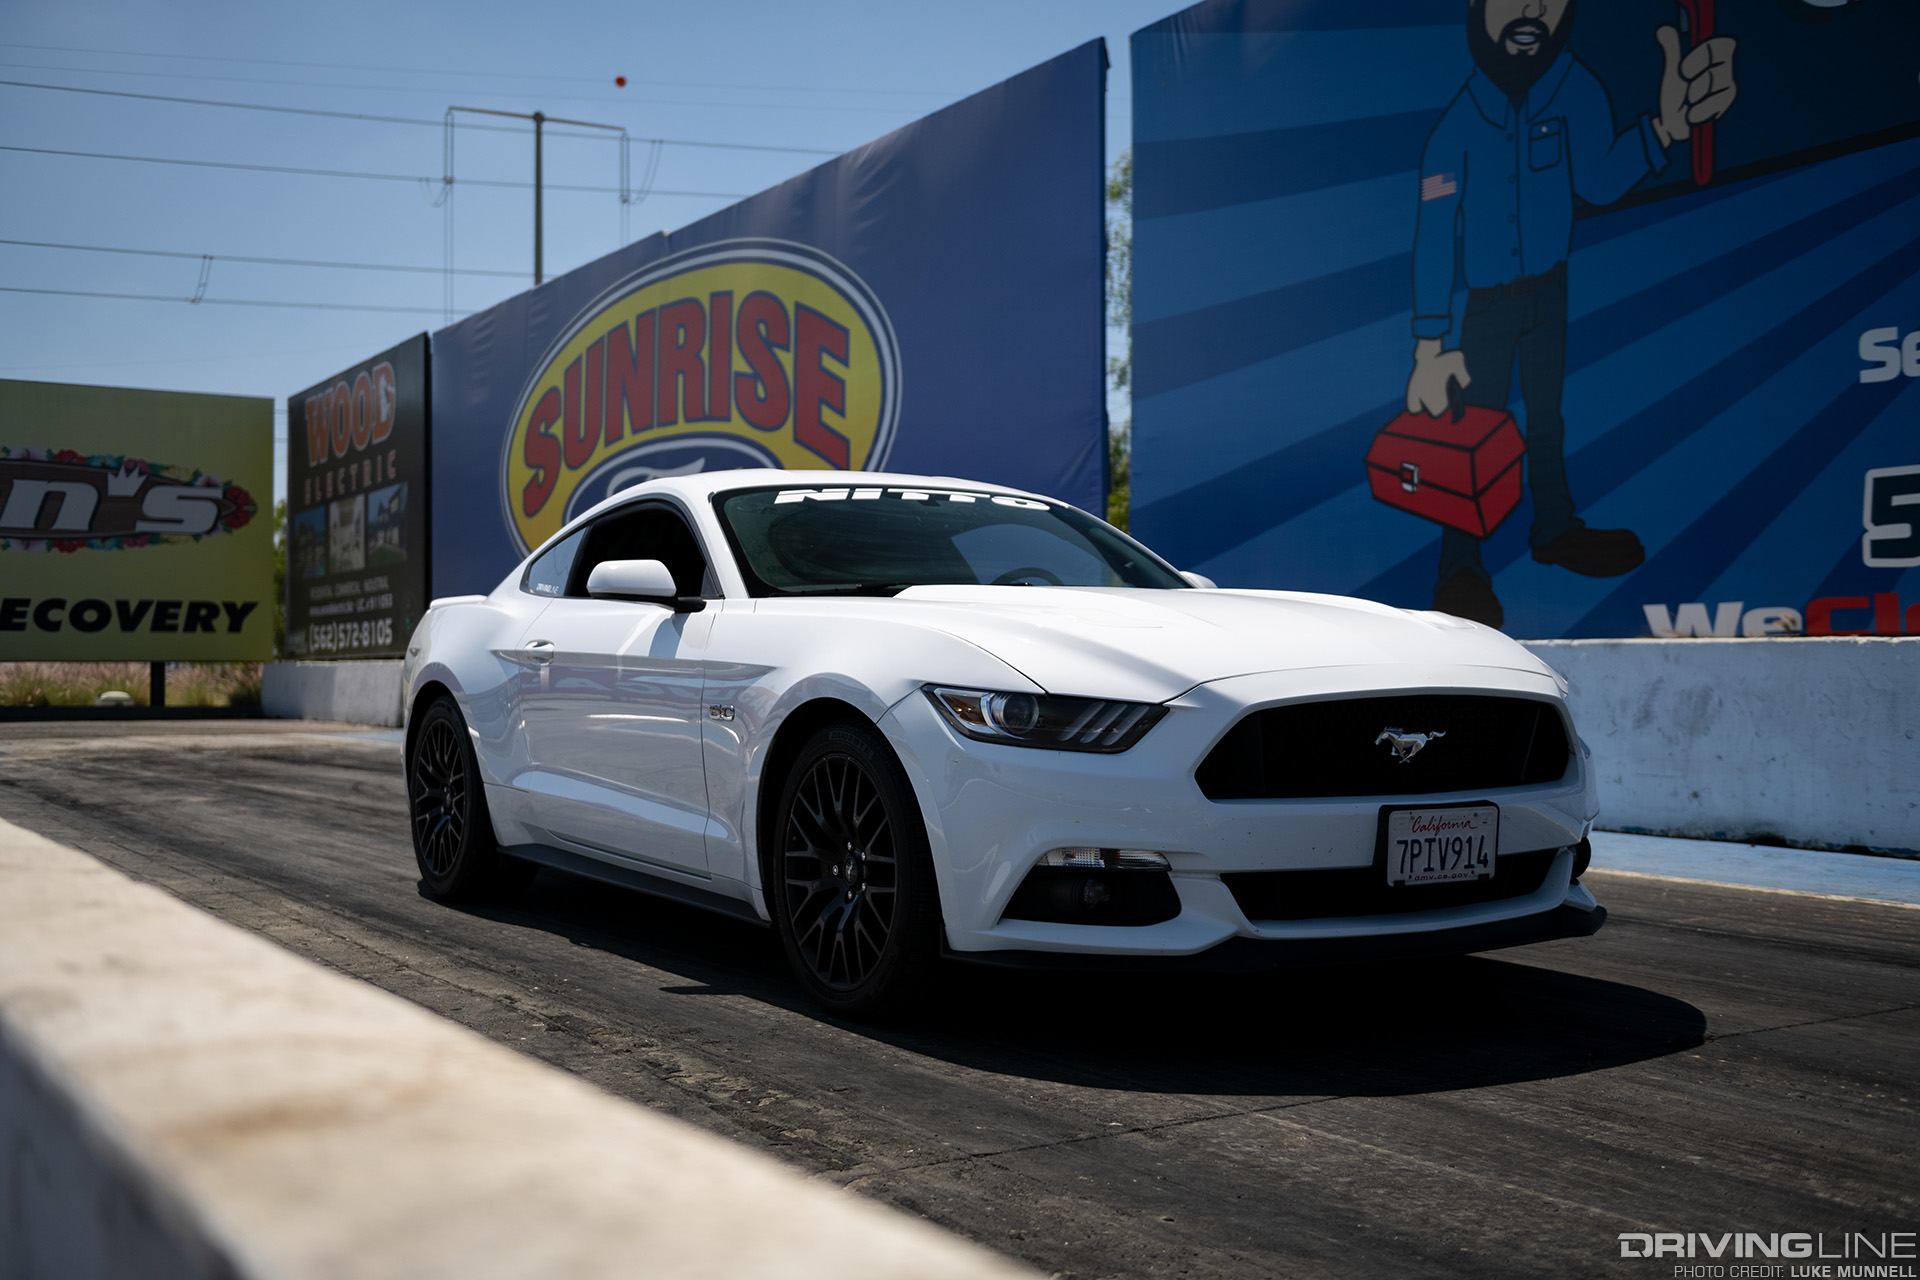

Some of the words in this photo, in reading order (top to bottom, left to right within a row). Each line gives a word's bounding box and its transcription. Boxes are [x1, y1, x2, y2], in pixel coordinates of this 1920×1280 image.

[304, 361, 396, 468] WOOD
[522, 290, 851, 518] SUNRISE
[304, 449, 397, 504] ELECTRIC
[774, 487, 1051, 512] NITTO
[0, 597, 259, 634] ECOVERY
[1411, 815, 1478, 835] California
[1396, 834, 1489, 874] 7PIV914
[1414, 872, 1469, 882] dmv.ca.gov
